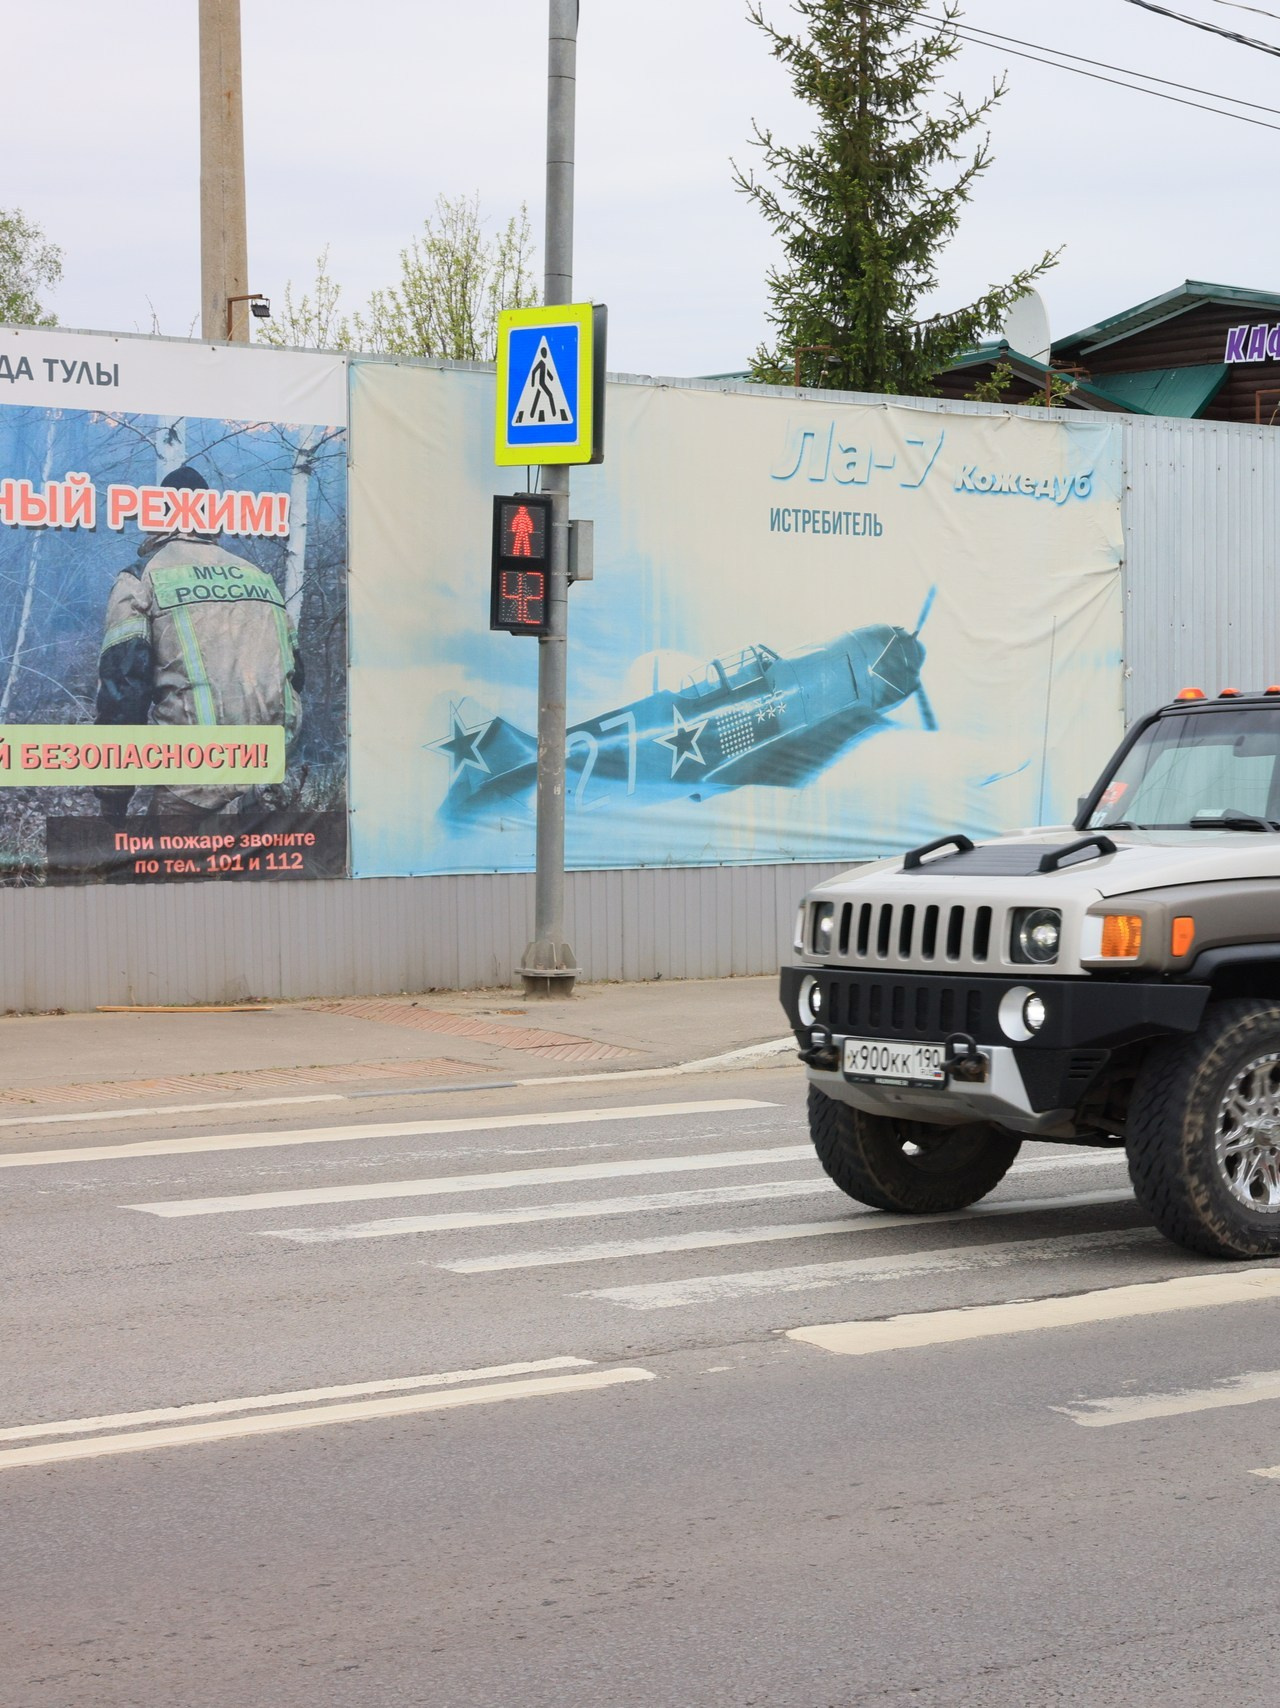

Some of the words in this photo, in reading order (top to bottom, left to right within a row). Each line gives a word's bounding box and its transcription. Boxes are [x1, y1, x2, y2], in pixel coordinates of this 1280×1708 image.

[42, 358, 119, 387] ТУЛЫ
[770, 418, 945, 489] Ла-7
[954, 464, 1095, 505] Кожедуб
[108, 487, 289, 533] РЕЖИМ!
[770, 508, 883, 537] ИСТРЕБИТЕЛЬ
[192, 565, 244, 580] МЧС
[175, 584, 274, 603] РОССИИ
[21, 743, 268, 770] БЕЗОПАСНОСТИ!
[114, 832, 154, 854] При
[160, 834, 235, 854] пожаре
[239, 832, 315, 848] звоните
[135, 860, 159, 873] по
[165, 858, 201, 873] тел.
[206, 854, 243, 872] 101
[249, 858, 260, 871] и
[265, 853, 303, 870] 112
[915, 1048, 940, 1068] 190
